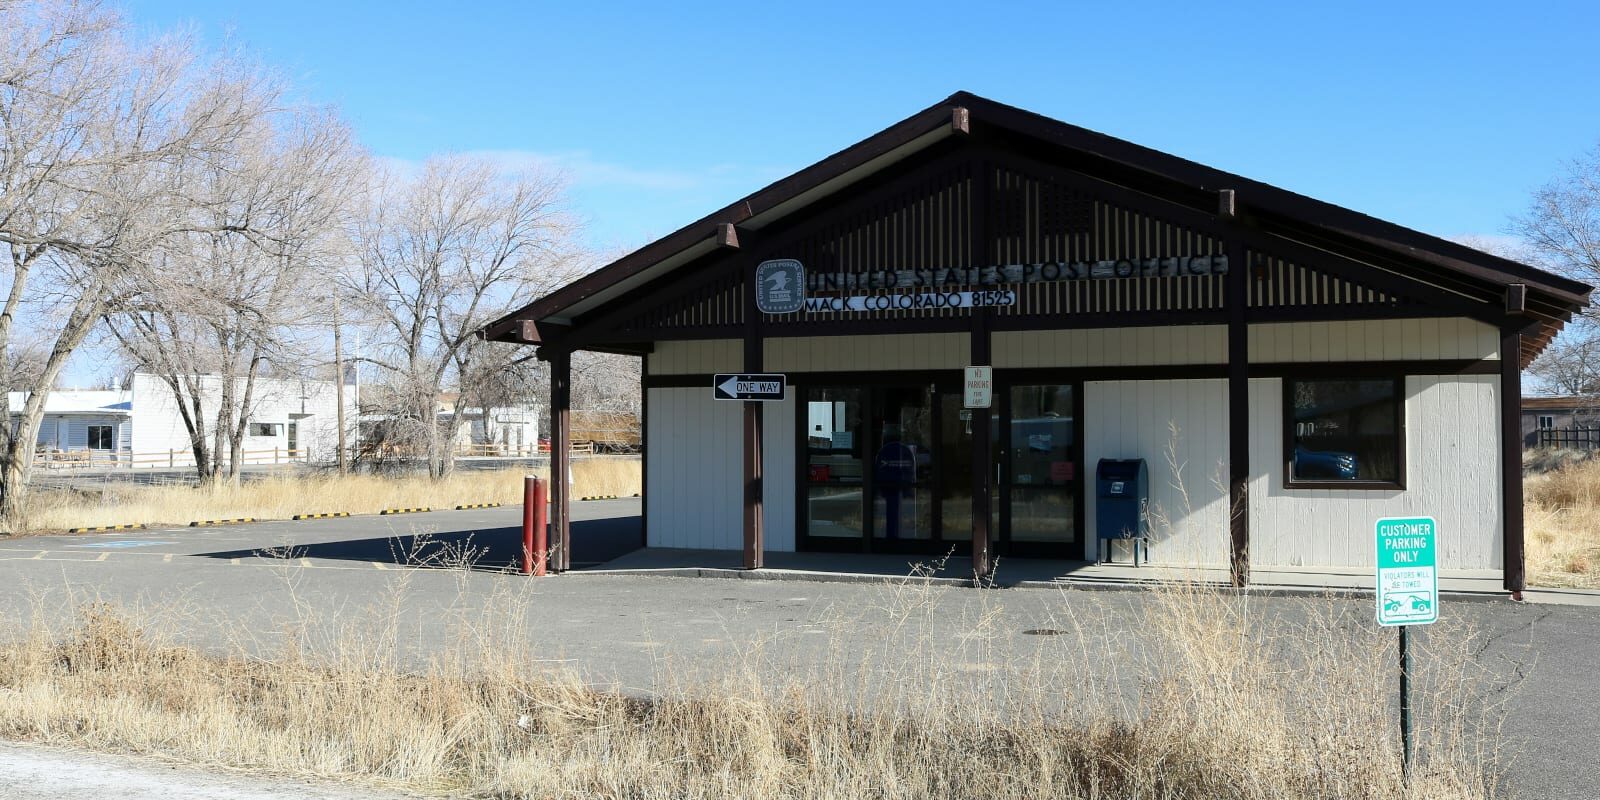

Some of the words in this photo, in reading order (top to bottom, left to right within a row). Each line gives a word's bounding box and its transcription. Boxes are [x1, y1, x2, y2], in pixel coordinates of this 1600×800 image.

[806, 269, 898, 291] UNITED
[914, 265, 1007, 287] STATES
[1023, 260, 1095, 283] POST
[1115, 254, 1225, 279] OFFICE
[864, 292, 962, 310] COLORADO
[972, 290, 1012, 306] 81525
[736, 382, 755, 392] ONE
[760, 382, 779, 392] WAY
[967, 380, 989, 389] PARKING
[1380, 523, 1431, 536] CUSTOMER
[1385, 537, 1427, 550] PARKING
[1393, 550, 1419, 563] ONLY
[1384, 571, 1415, 580] VIOLATORS
[1417, 570, 1430, 578] WILL
[1402, 580, 1421, 588] TOWED
